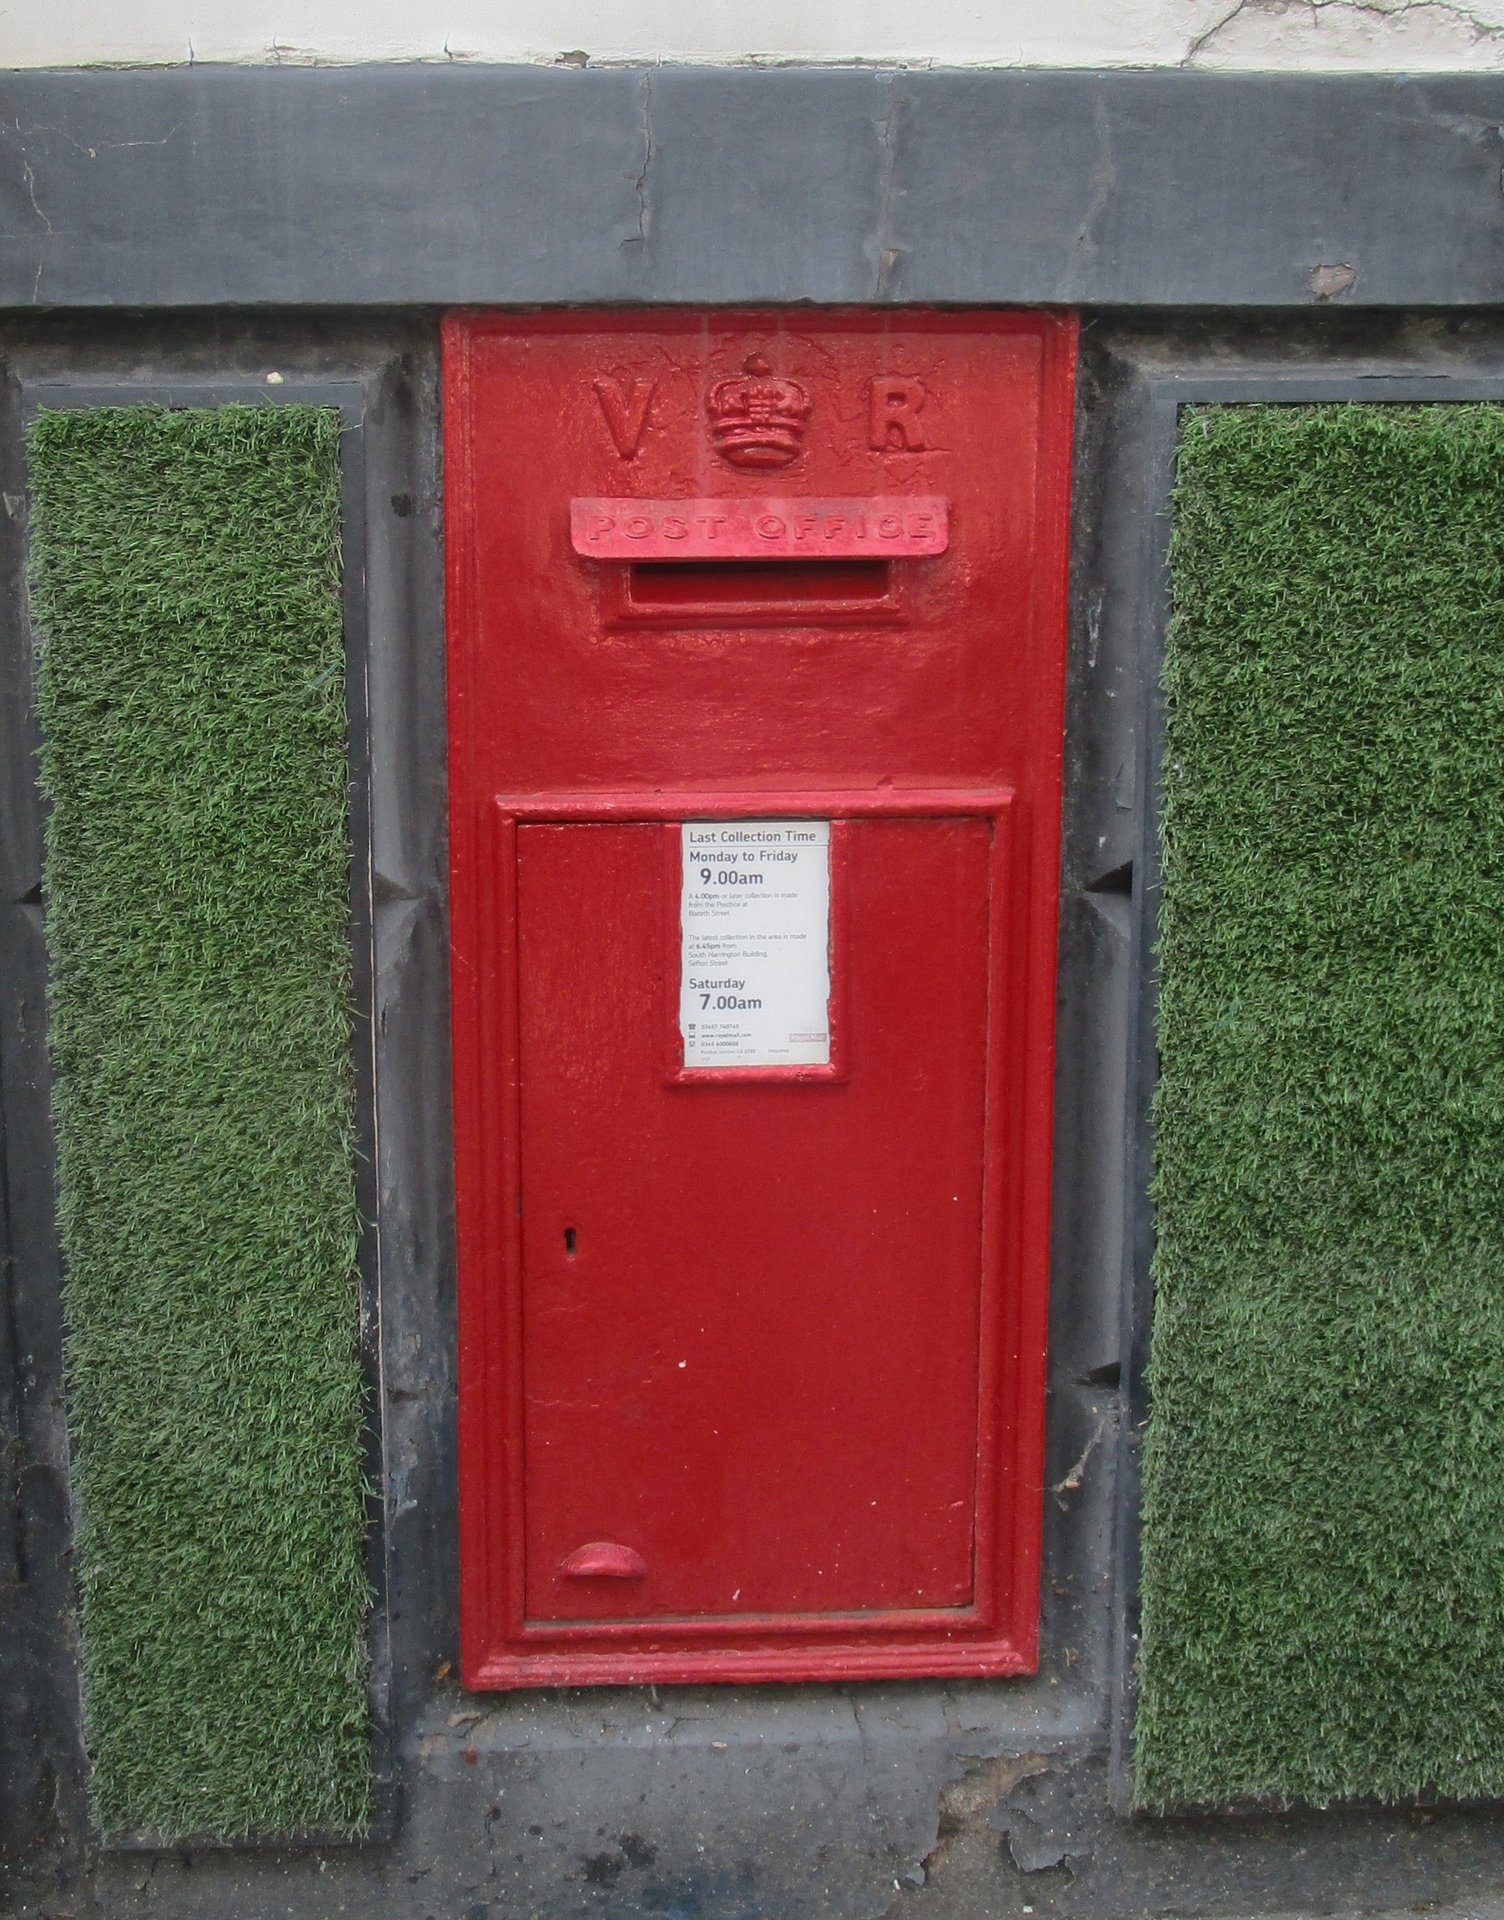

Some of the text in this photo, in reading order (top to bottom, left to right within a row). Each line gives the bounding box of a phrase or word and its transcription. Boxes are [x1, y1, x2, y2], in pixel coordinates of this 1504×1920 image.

[593, 375, 925, 460] V R
[589, 514, 935, 540] POST OFFICE
[690, 831, 816, 843] Last Collection Time
[690, 851, 798, 864] Monday to Friday
[700, 868, 763, 885] 9.00am
[689, 978, 745, 990] Saturday
[699, 994, 761, 1010] 7.00am
